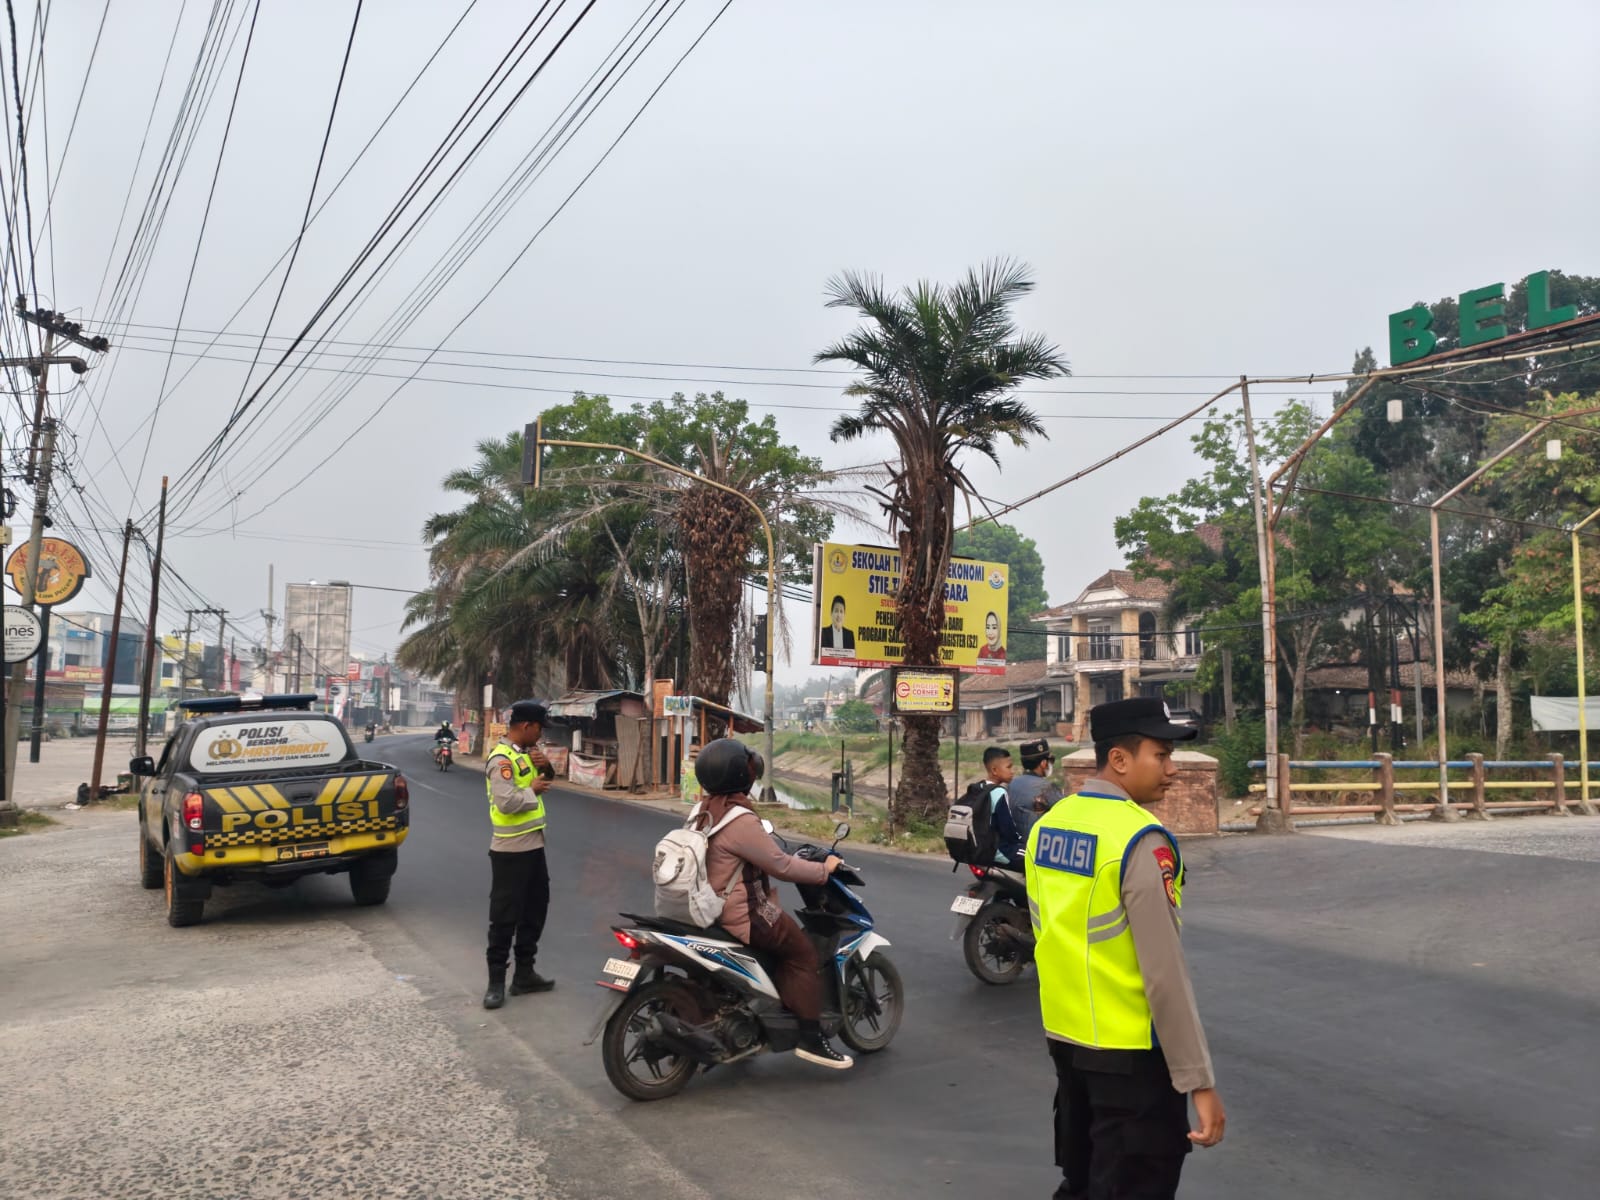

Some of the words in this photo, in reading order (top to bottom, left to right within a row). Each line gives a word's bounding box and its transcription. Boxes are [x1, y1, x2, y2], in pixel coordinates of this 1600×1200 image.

[1389, 270, 1577, 366] BEL
[852, 551, 890, 571] SEKOLAH
[948, 562, 984, 581] EKONOMI
[869, 575, 889, 594] STIE
[944, 582, 968, 602] GARA
[876, 610, 897, 627] PENERI
[858, 626, 887, 643] PROGRAM
[940, 632, 966, 649] AGISTER
[238, 726, 284, 740] POLISI
[246, 737, 289, 747] BERSAMA
[241, 742, 329, 758] MASYARAKAT
[300, 752, 330, 760] MELAYANI
[222, 800, 379, 833] POLISI
[1038, 832, 1092, 869] POLISI
